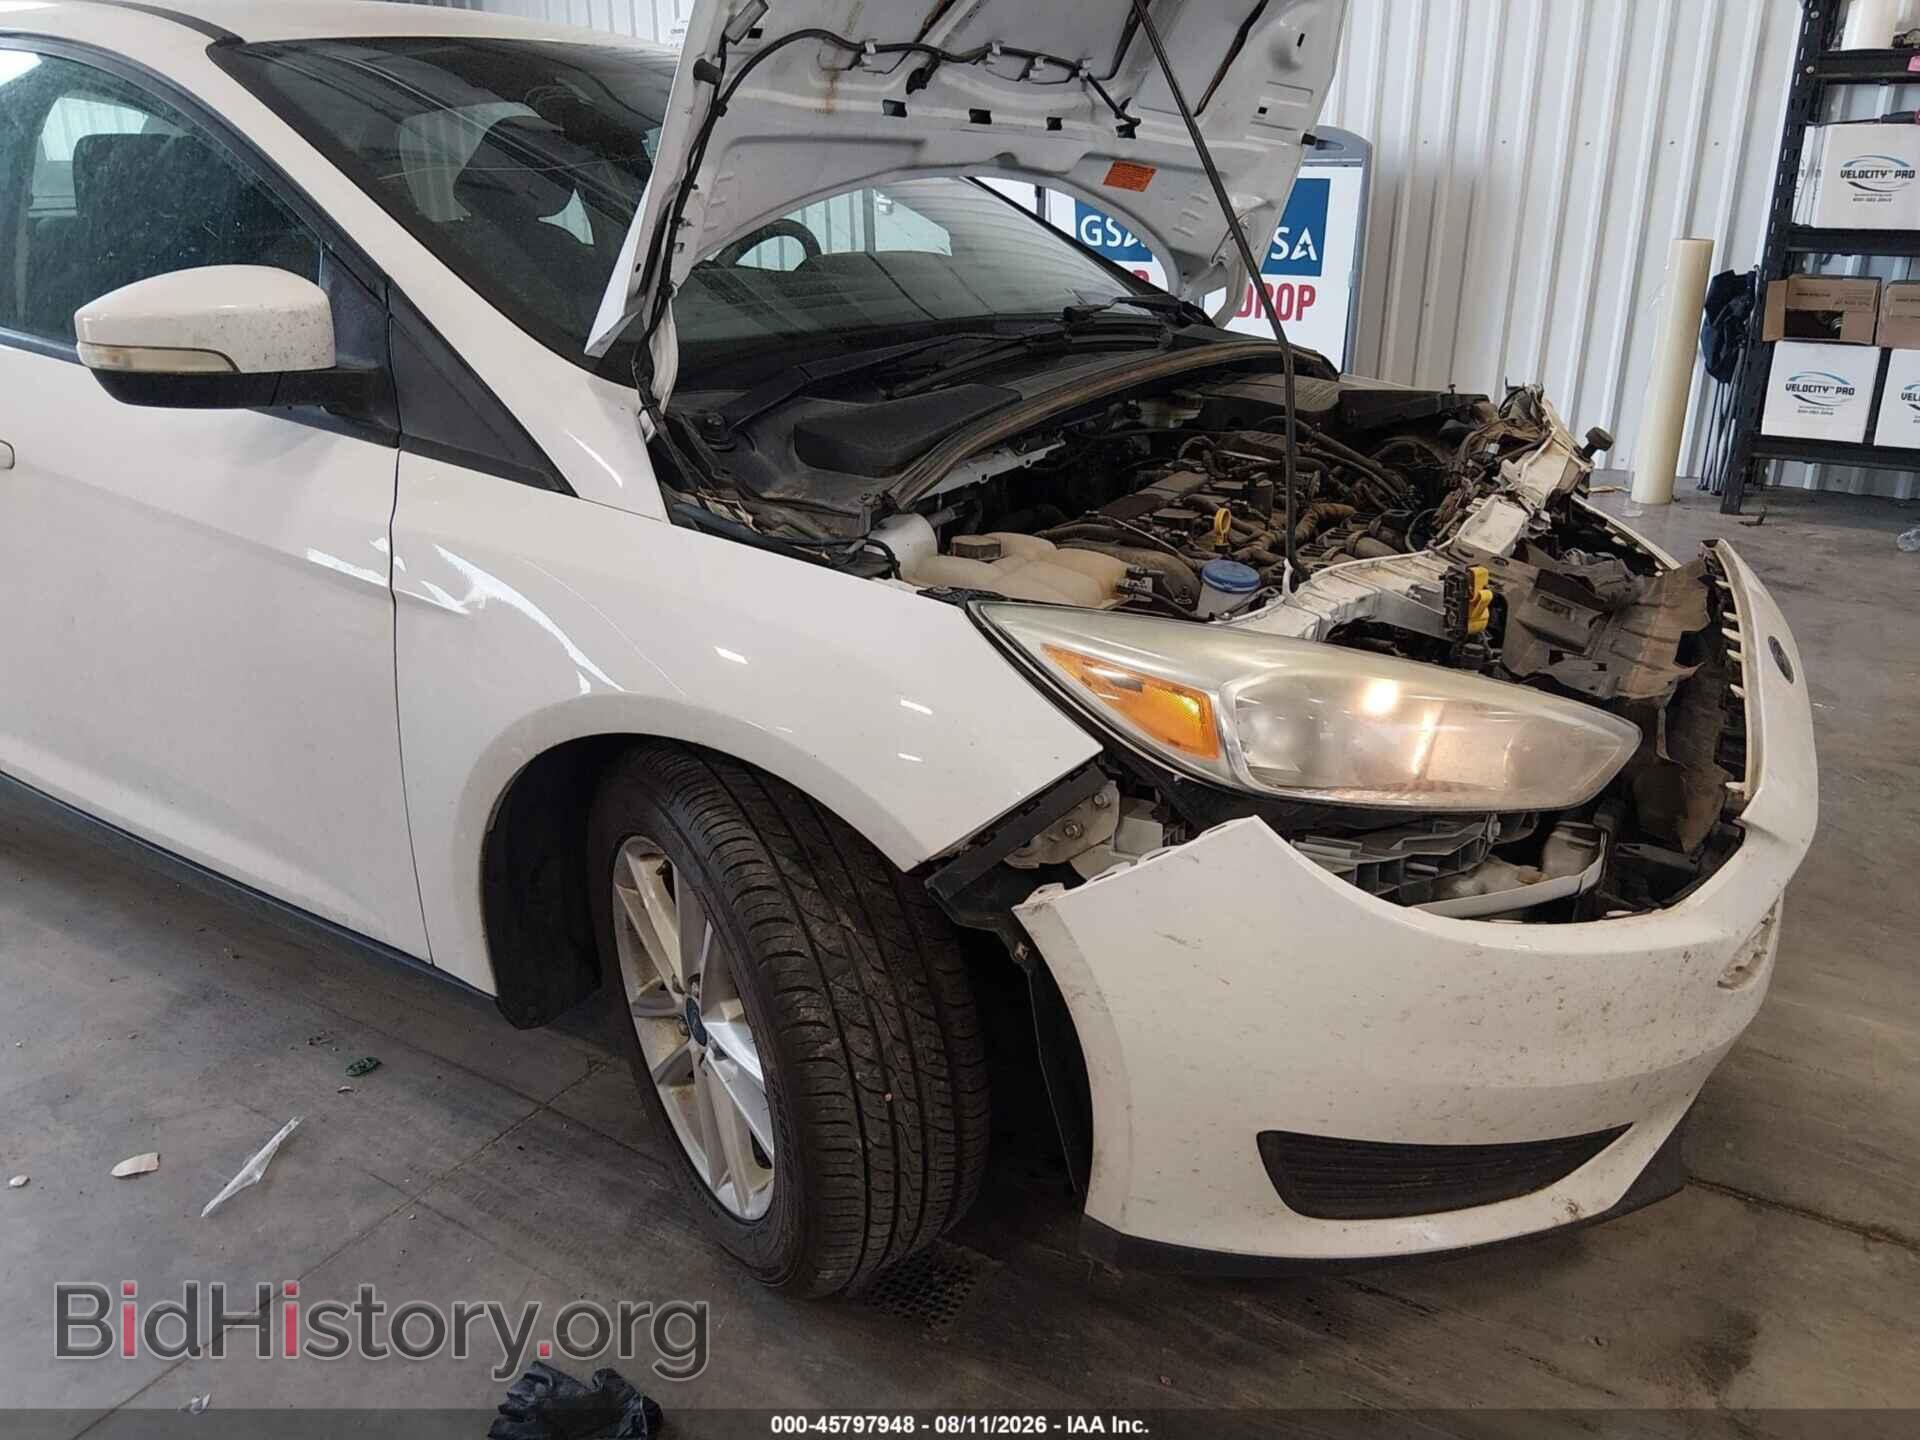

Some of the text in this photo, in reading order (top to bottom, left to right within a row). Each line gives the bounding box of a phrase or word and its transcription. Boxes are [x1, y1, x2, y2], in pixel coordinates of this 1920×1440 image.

[1894, 169, 1916, 179] PRO
[1270, 226, 1318, 261] SA
[1835, 386, 1855, 396] PRO
[1900, 392, 1920, 402] VEL
